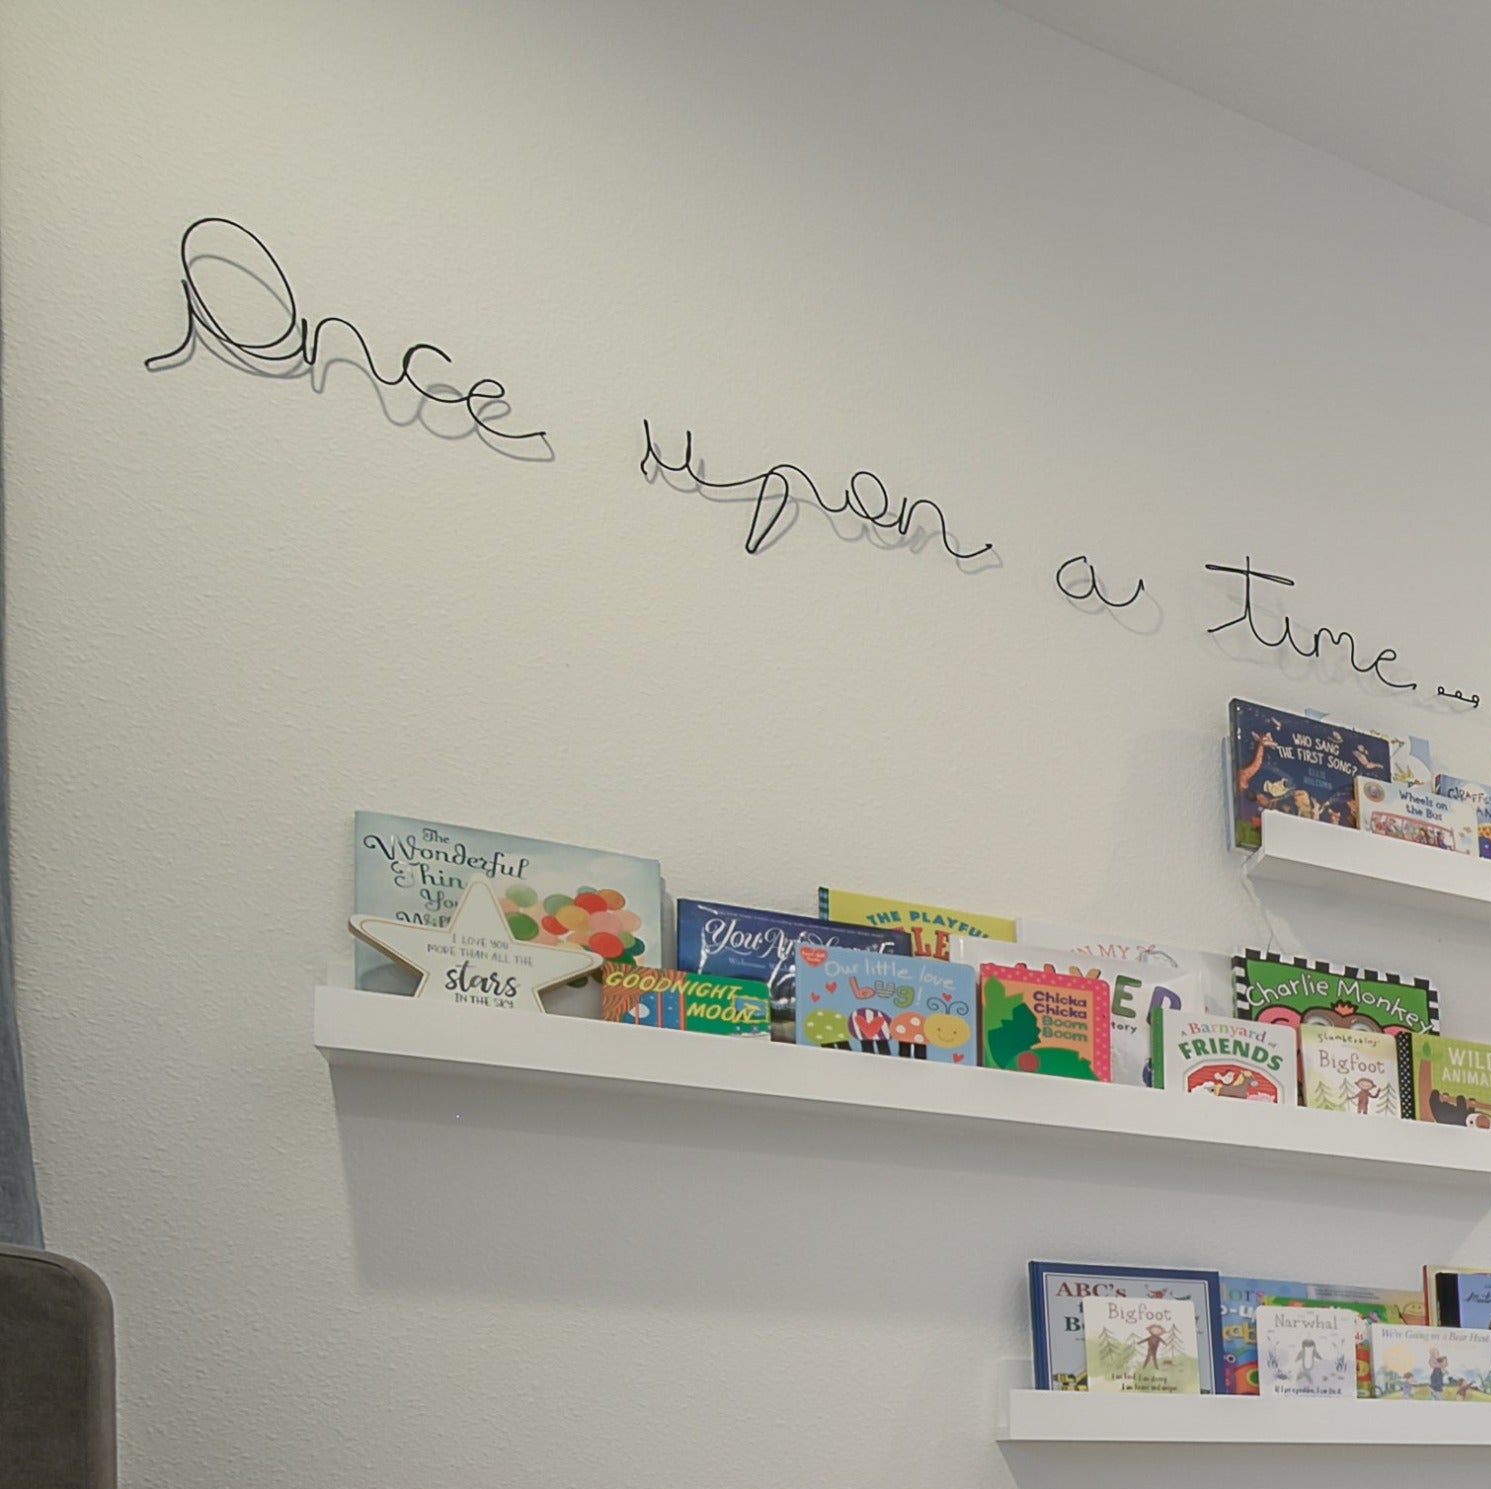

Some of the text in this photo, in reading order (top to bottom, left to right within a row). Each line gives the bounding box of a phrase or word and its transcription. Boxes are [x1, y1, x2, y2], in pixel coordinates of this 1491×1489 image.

[145, 218, 546, 438] Once
[641, 418, 993, 558] upon
[1055, 555, 1144, 607] a
[1292, 733, 1340, 756] WHO SANG
[1277, 746, 1358, 777] THE FIRST SONG?
[1399, 790, 1449, 812] Wheels on
[1406, 804, 1443, 821] the Bus
[422, 828, 450, 844] The
[363, 834, 530, 880] Wonderful
[390, 860, 466, 889] Thin
[866, 911, 902, 926] THE
[909, 910, 990, 938] PLAYFU
[461, 936, 486, 948] LOVE
[490, 939, 509, 950] YOU
[704, 917, 763, 956] You
[760, 927, 795, 958] Ar
[427, 943, 534, 966] MORE THAN ALL THE
[445, 960, 521, 997] stars
[824, 958, 956, 990] Our little love
[606, 971, 744, 1001] GOODNIGHT
[848, 975, 923, 1009] bug!
[455, 993, 514, 1009] IN THE SKY
[1033, 990, 1088, 1008] Chicka
[1245, 973, 1435, 1036] Charlie Monkey
[687, 1002, 760, 1024] MOON
[1033, 1003, 1088, 1019] Chicka
[1042, 1014, 1089, 1031] Boom
[1111, 1021, 1138, 1035] tory
[1188, 1022, 1268, 1043] Barnyard
[1042, 1027, 1089, 1042] Boom
[1178, 1036, 1285, 1072] FRIENDS
[1319, 1049, 1386, 1075] Bigfoot
[1055, 1281, 1128, 1299] ABC's
[1107, 1302, 1172, 1324] Bigfoot
[1274, 1313, 1338, 1330] Narwhal
[1381, 1328, 1404, 1339] We're
[1405, 1329, 1429, 1342] Going
[1449, 1332, 1468, 1342] Bear
[1469, 1333, 1490, 1343] Hunt
